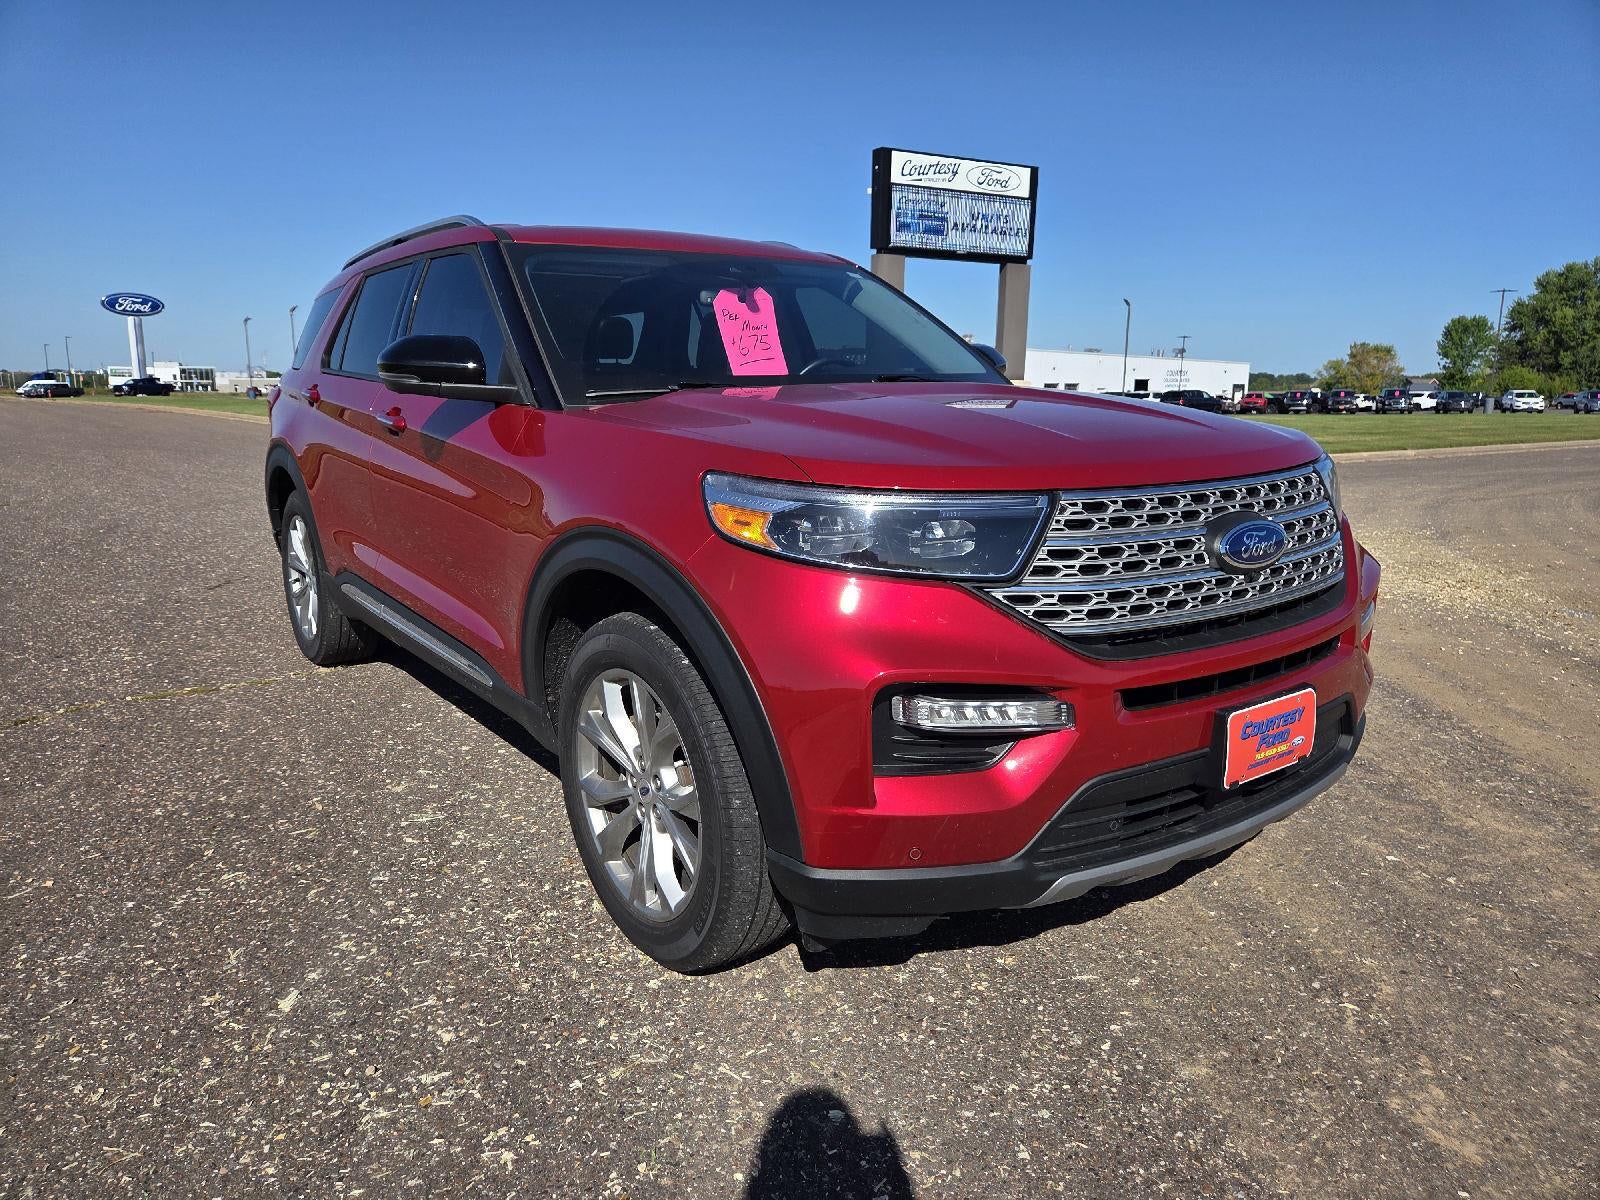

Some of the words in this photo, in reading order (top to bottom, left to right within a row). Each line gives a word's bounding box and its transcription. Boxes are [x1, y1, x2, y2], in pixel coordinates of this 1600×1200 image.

[901, 159, 962, 182] Courtesy
[976, 167, 1012, 189] Ford
[115, 296, 152, 313] Ford
[721, 308, 740, 323] PER
[1241, 530, 1277, 559] Ford
